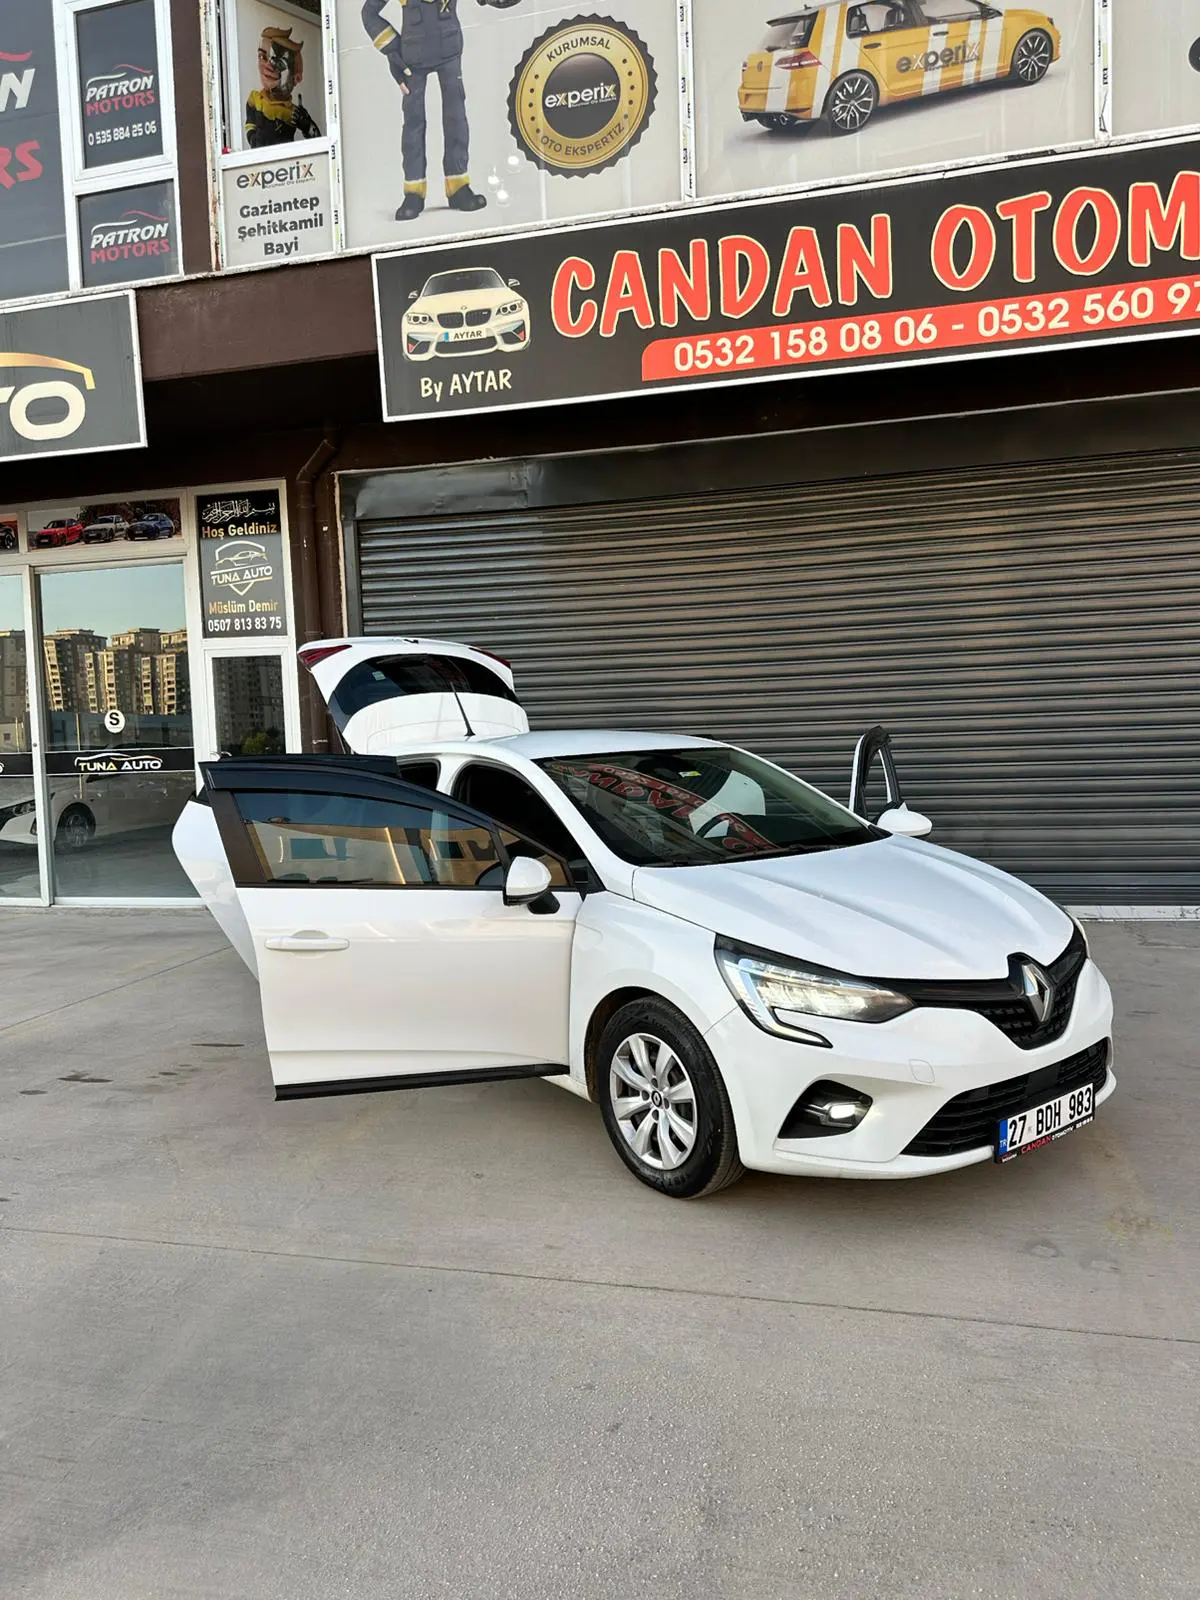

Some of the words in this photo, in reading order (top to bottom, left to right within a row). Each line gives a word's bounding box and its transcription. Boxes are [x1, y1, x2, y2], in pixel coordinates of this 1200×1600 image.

[547, 37, 611, 61] KURUMSAL
[86, 75, 153, 102] PATRON
[545, 83, 616, 109] experix
[86, 90, 155, 117] MOTORS
[88, 133, 94, 146] 0
[96, 129, 112, 144] 535
[113, 126, 130, 140] 884
[132, 123, 143, 137] 25
[144, 120, 157, 134] 06
[541, 136, 562, 153] OTO
[237, 161, 313, 189] experix
[240, 196, 320, 219] Gaziantep
[91, 223, 168, 249] PATRON
[238, 214, 323, 242] Şehitkamil
[91, 239, 170, 264] MOTORS
[264, 237, 298, 257] Bayi
[551, 213, 893, 338] CANDAN
[453, 329, 482, 341] AYTAR
[674, 335, 754, 373] 0532
[770, 325, 828, 361] 158
[839, 319, 882, 355] 08
[894, 313, 938, 349] 06
[977, 297, 1069, 337] 0532
[1082, 287, 1154, 325] 560
[420, 378, 442, 402] By
[449, 369, 512, 397] AYTAR
[202, 526, 224, 540] Hoş
[229, 521, 277, 537] Geldiniz
[211, 573, 240, 585] TUNA
[243, 566, 272, 580] AUTO
[209, 600, 245, 614] Müslüm
[249, 600, 278, 613] Demir
[208, 619, 231, 632] 0507
[234, 617, 252, 631] 813
[255, 617, 266, 630] 83
[269, 616, 282, 629] 75
[109, 712, 120, 726] S
[79, 762, 118, 772] TUNA
[121, 760, 161, 770] AUTO
[1009, 1115, 1027, 1148] 27
[1036, 1100, 1061, 1136] BDH
[1069, 1087, 1092, 1120] 983
[1000, 1139, 1007, 1149] TR
